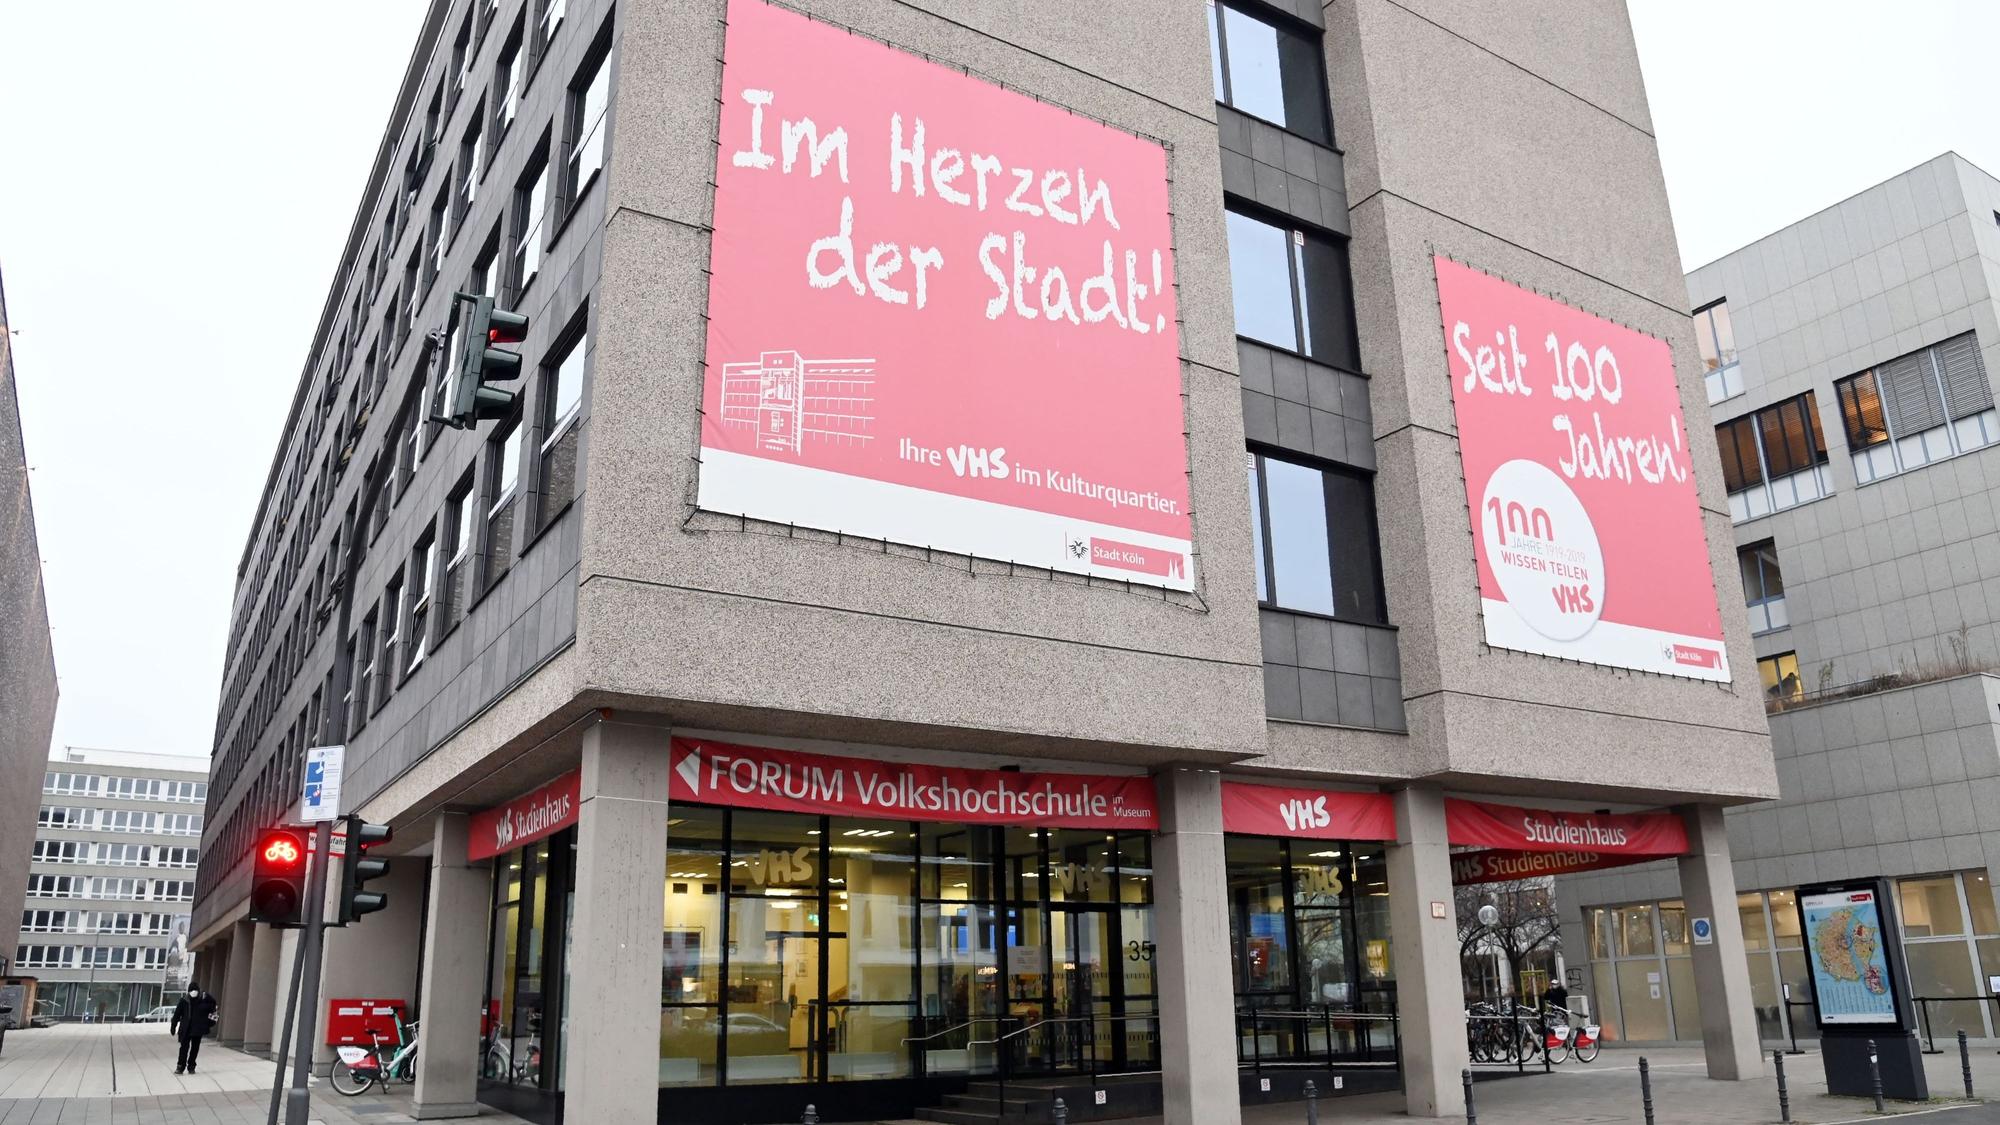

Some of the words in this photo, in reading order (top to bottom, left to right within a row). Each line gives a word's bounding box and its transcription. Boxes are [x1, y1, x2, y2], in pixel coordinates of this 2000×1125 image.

[733, 88, 849, 183] Im
[890, 112, 1120, 230] Herzen
[806, 196, 943, 310] der
[979, 231, 1166, 334] Stadt!
[1453, 320, 1532, 396] Seit
[1545, 331, 1622, 404] 100
[1552, 412, 1687, 484] Jahren!
[899, 438, 942, 467] Ihre
[946, 444, 1010, 480] VHS
[1015, 463, 1041, 488] im
[1046, 470, 1181, 516] Kulturquartier.
[1093, 545, 1120, 561] Stadt
[1122, 551, 1146, 566] Köln
[1511, 537, 1543, 555] JAHRE
[1501, 550, 1547, 572] WISSEN
[1549, 561, 1589, 581] TEILEN
[1552, 584, 1594, 613] VHS
[710, 756, 843, 803] FORUM
[854, 770, 1108, 818] Volkshochschule
[1112, 794, 1124, 805] im
[515, 793, 570, 840] Studienhaus
[1113, 806, 1151, 817] Museum
[1279, 796, 1331, 831] VHS
[1525, 817, 1627, 846] Studienhaus
[745, 846, 813, 885] VHS
[1487, 850, 1599, 877] Studienhaus
[1129, 940, 1152, 962] 35
